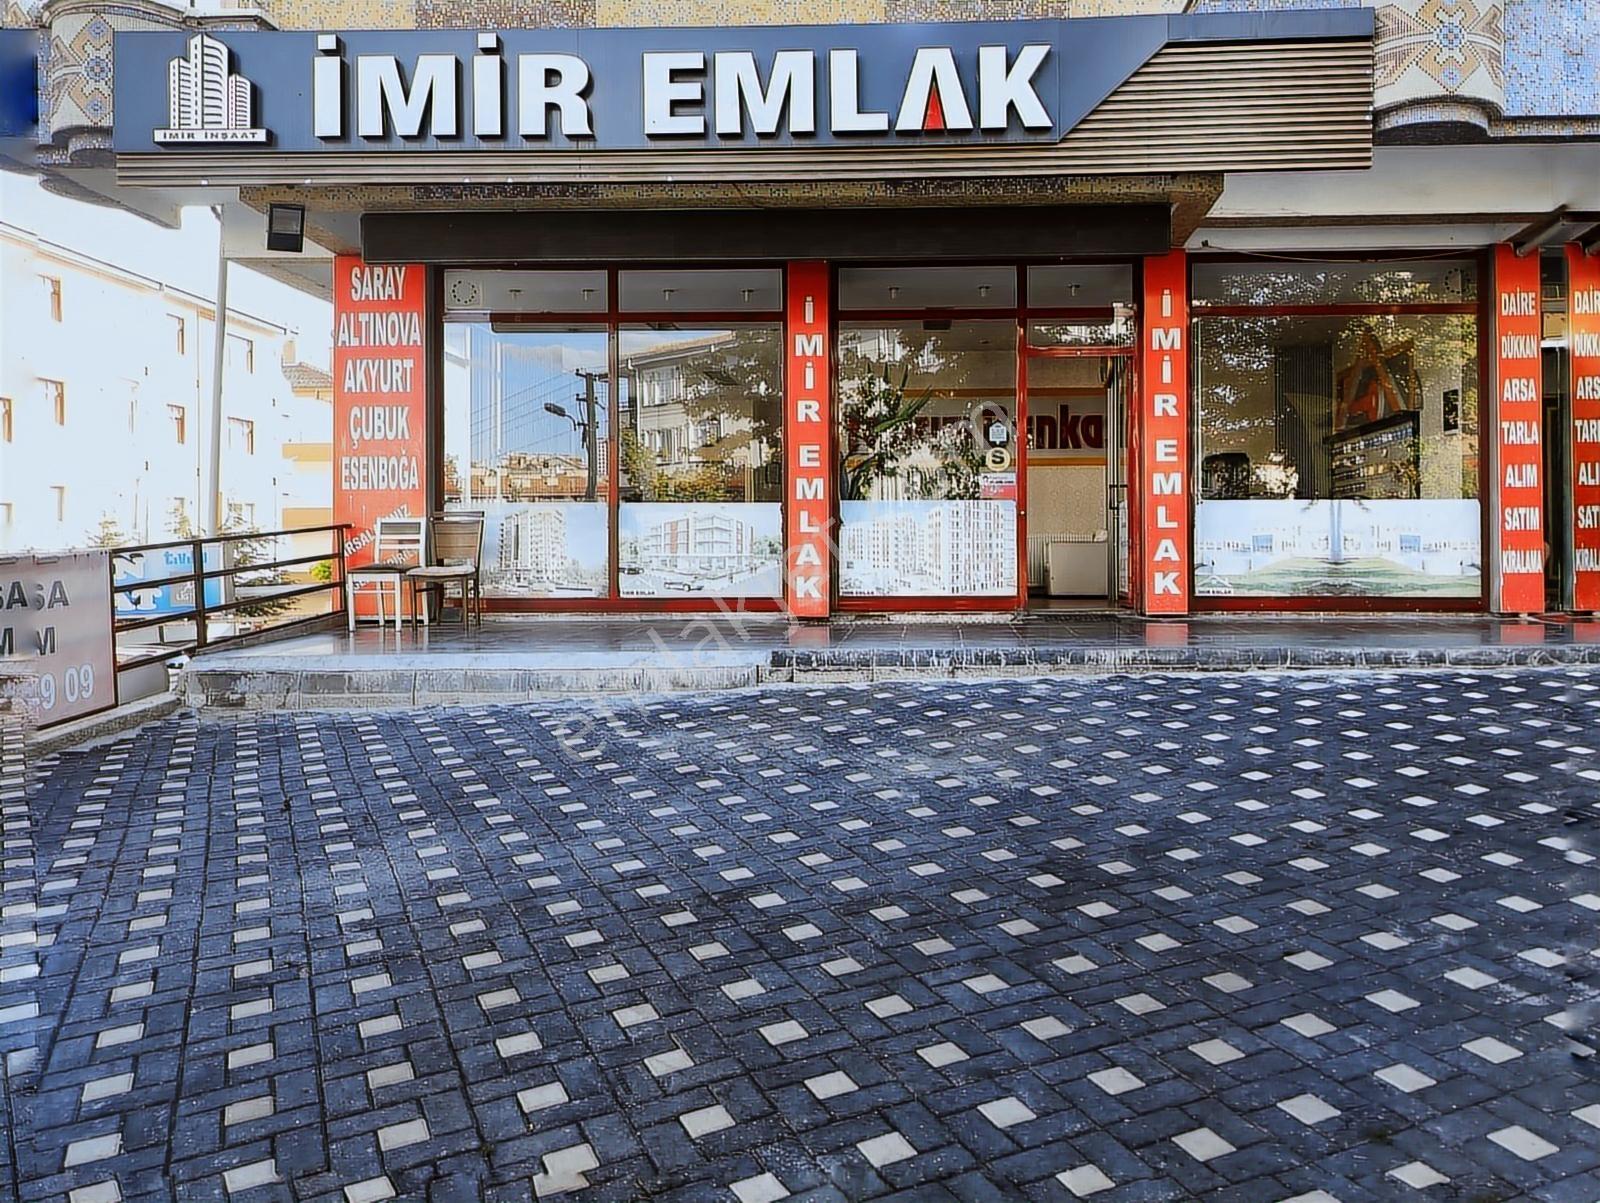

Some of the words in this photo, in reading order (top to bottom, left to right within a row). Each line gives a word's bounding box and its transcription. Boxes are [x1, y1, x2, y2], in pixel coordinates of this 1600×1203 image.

[313, 33, 595, 138] İMİR
[643, 44, 1054, 136] EMLAK
[351, 266, 406, 301] SARAY
[1501, 286, 1536, 316] DAİRE
[337, 312, 422, 347] ALTINOVA
[1501, 331, 1538, 359] DÜKKAN
[344, 358, 414, 393] AKYURT
[1503, 378, 1537, 402] ARSA
[349, 406, 410, 449] ÇUBUK
[1501, 420, 1539, 445] TARLA
[1505, 463, 1538, 488] ALIM
[1504, 506, 1540, 531] SATIM
[1502, 543, 1544, 574] KİRALAMA
